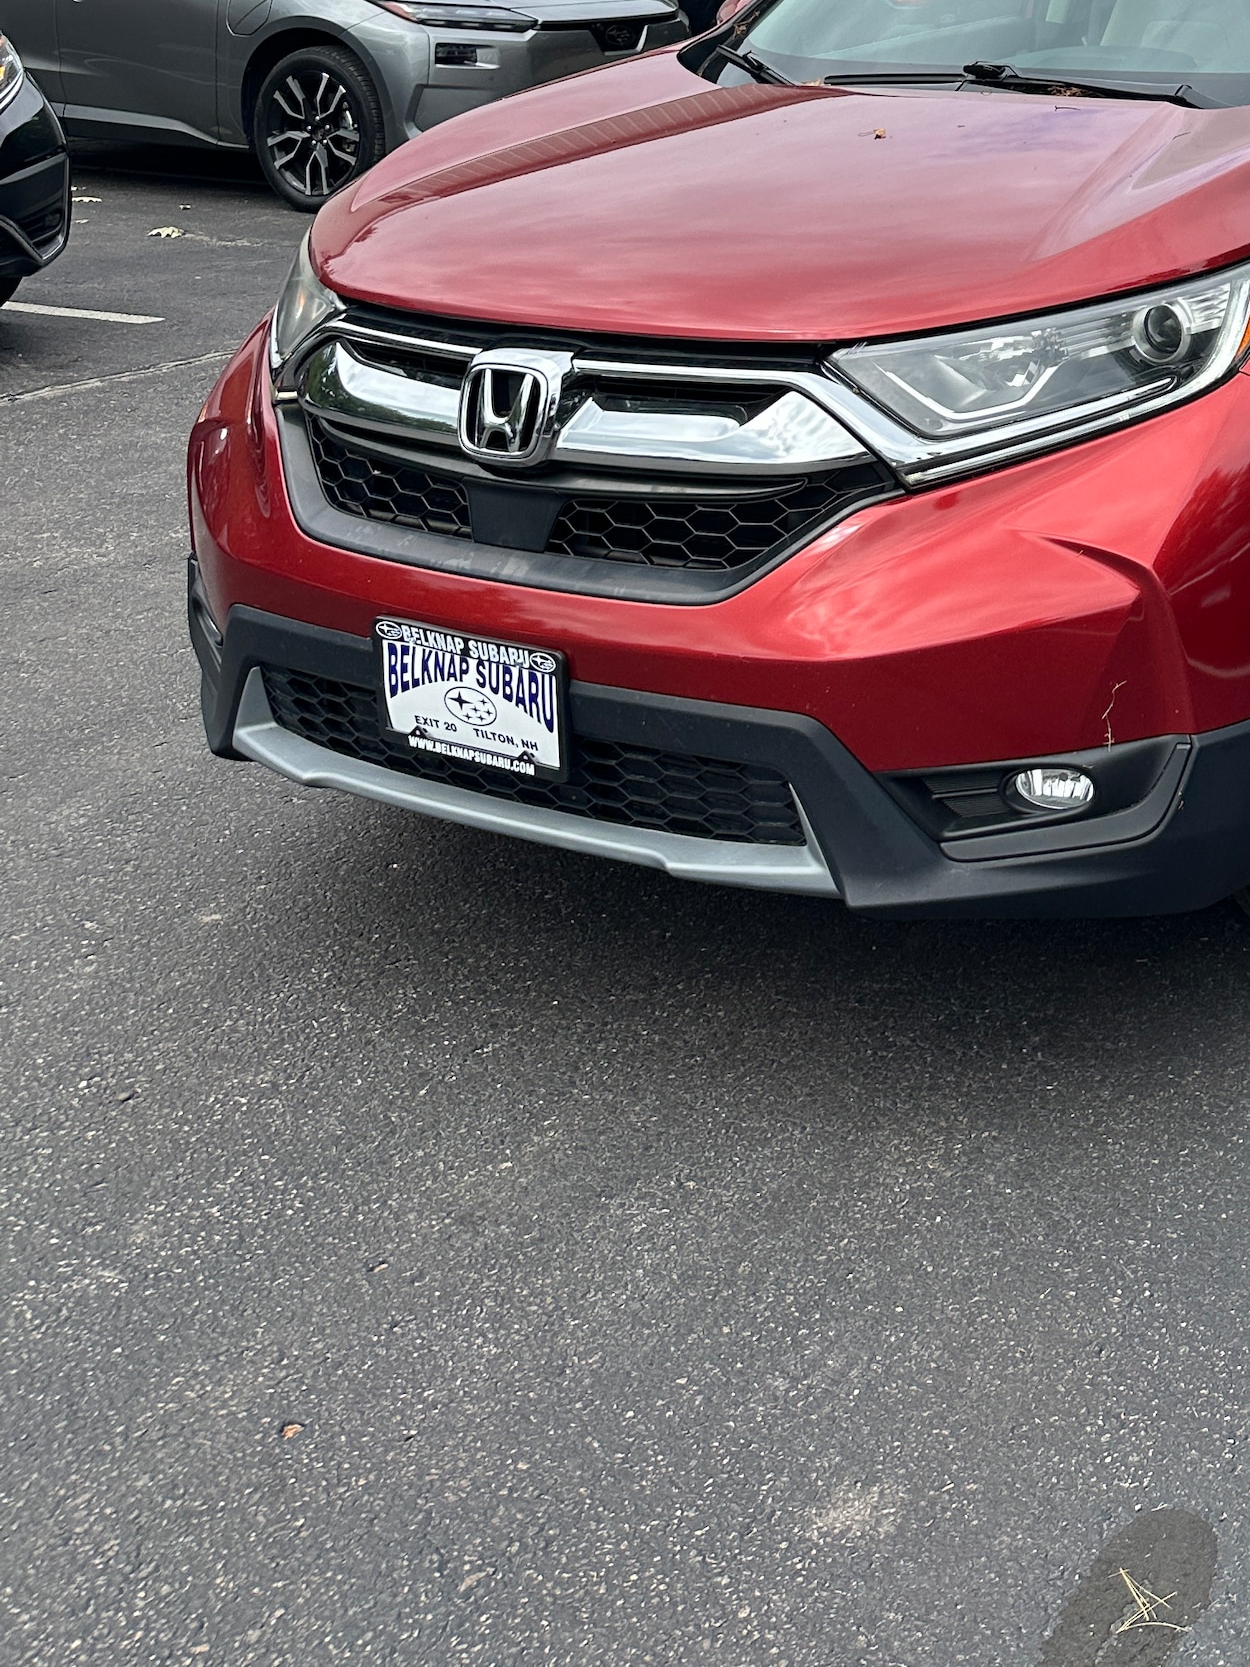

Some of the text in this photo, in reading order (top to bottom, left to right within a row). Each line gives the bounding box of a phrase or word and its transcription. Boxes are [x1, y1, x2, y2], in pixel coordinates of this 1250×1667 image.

[400, 624, 530, 669] BELKNAP SUBARU
[387, 642, 555, 733] BELKNAP SUBARU
[414, 714, 539, 751] EXIT 20 TILTON, NH
[407, 734, 535, 776] WWW.BELKNAPSUBARU.COM
